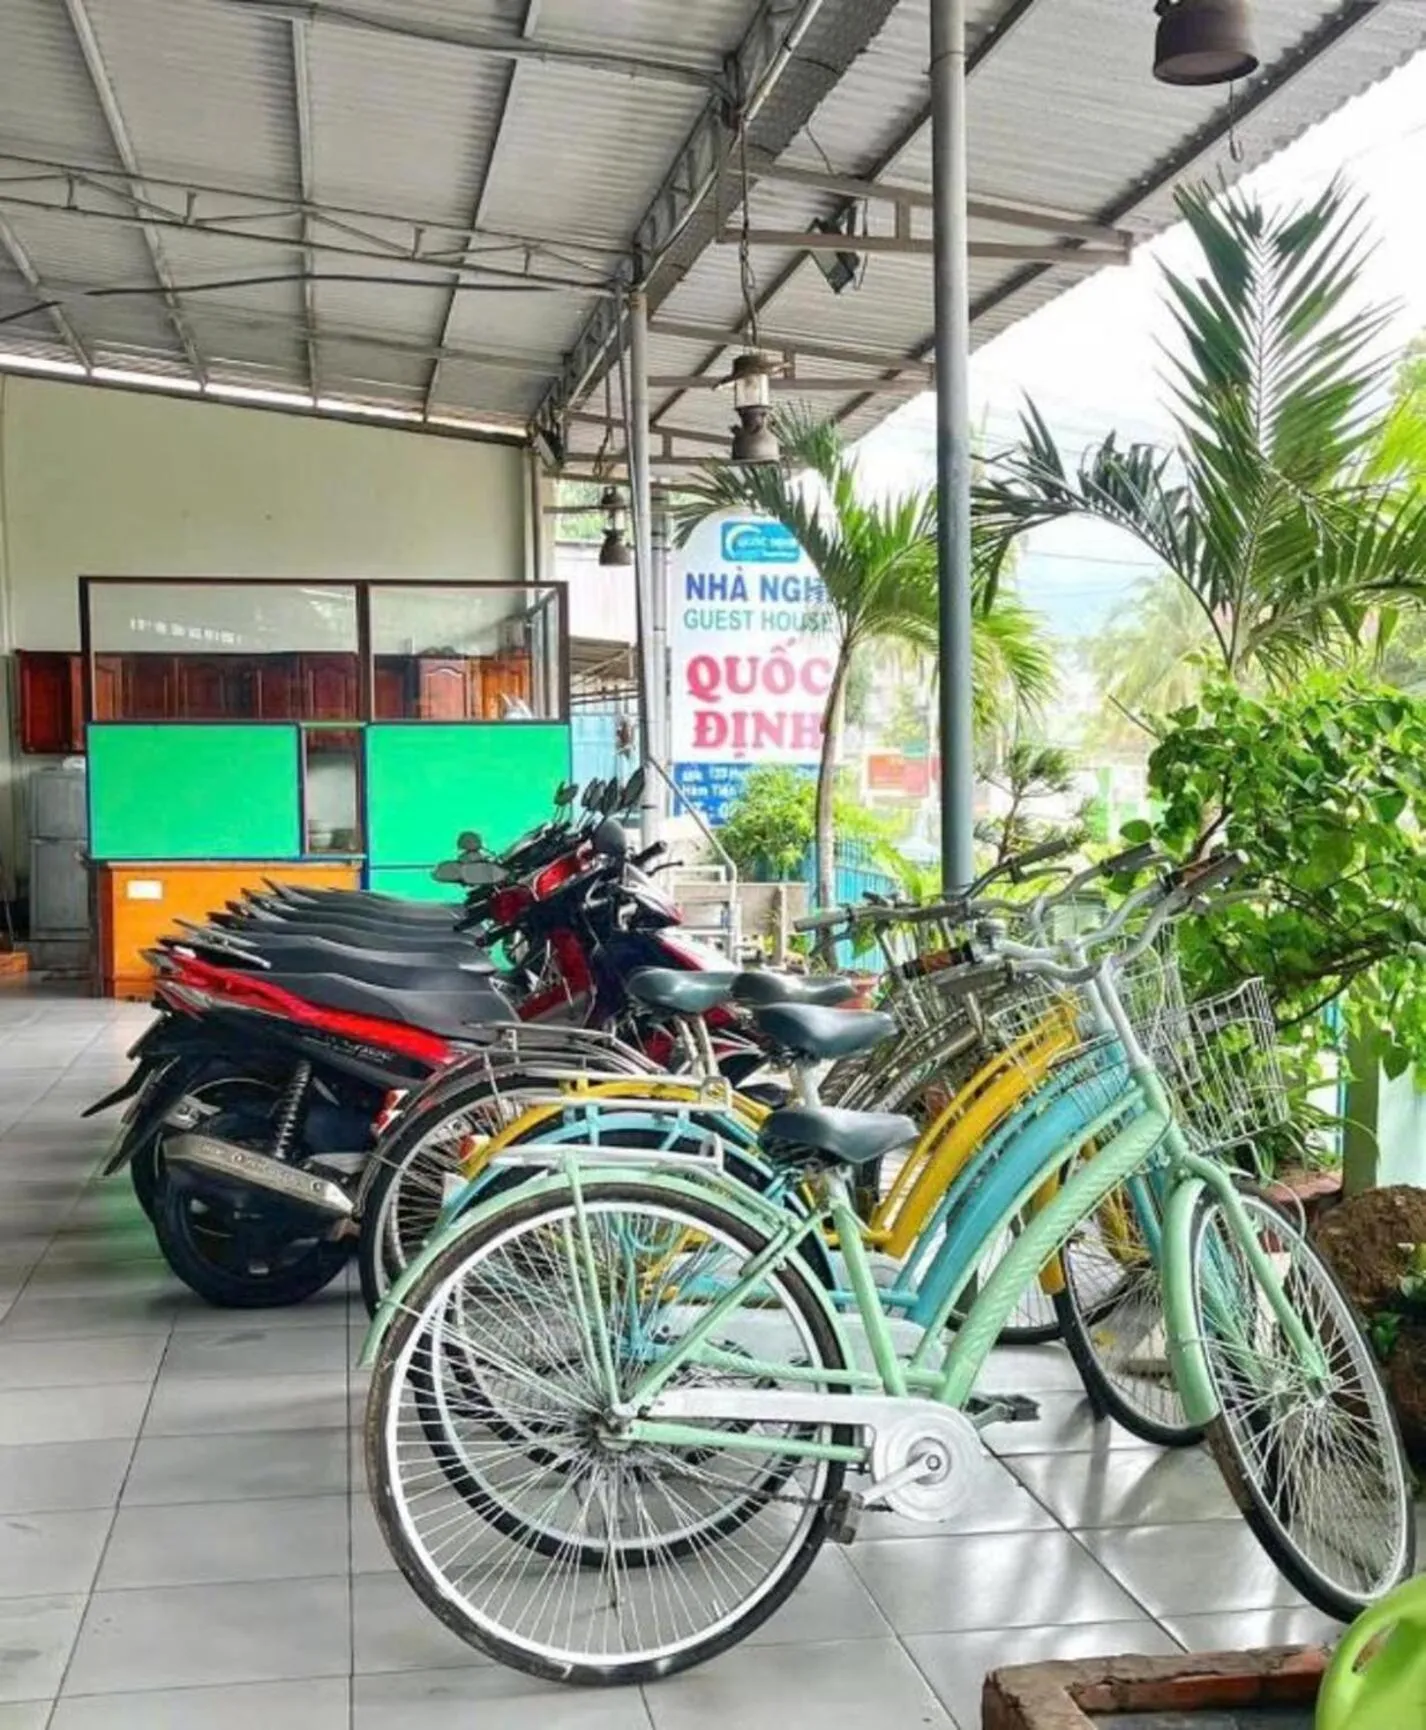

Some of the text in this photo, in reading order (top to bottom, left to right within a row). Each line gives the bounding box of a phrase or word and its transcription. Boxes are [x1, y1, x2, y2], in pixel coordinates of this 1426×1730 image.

[759, 574, 825, 602] NGH
[684, 609, 832, 631] GUEST HOUSE
[686, 636, 831, 703] QUỐC
[692, 710, 822, 758] ĐỊNH
